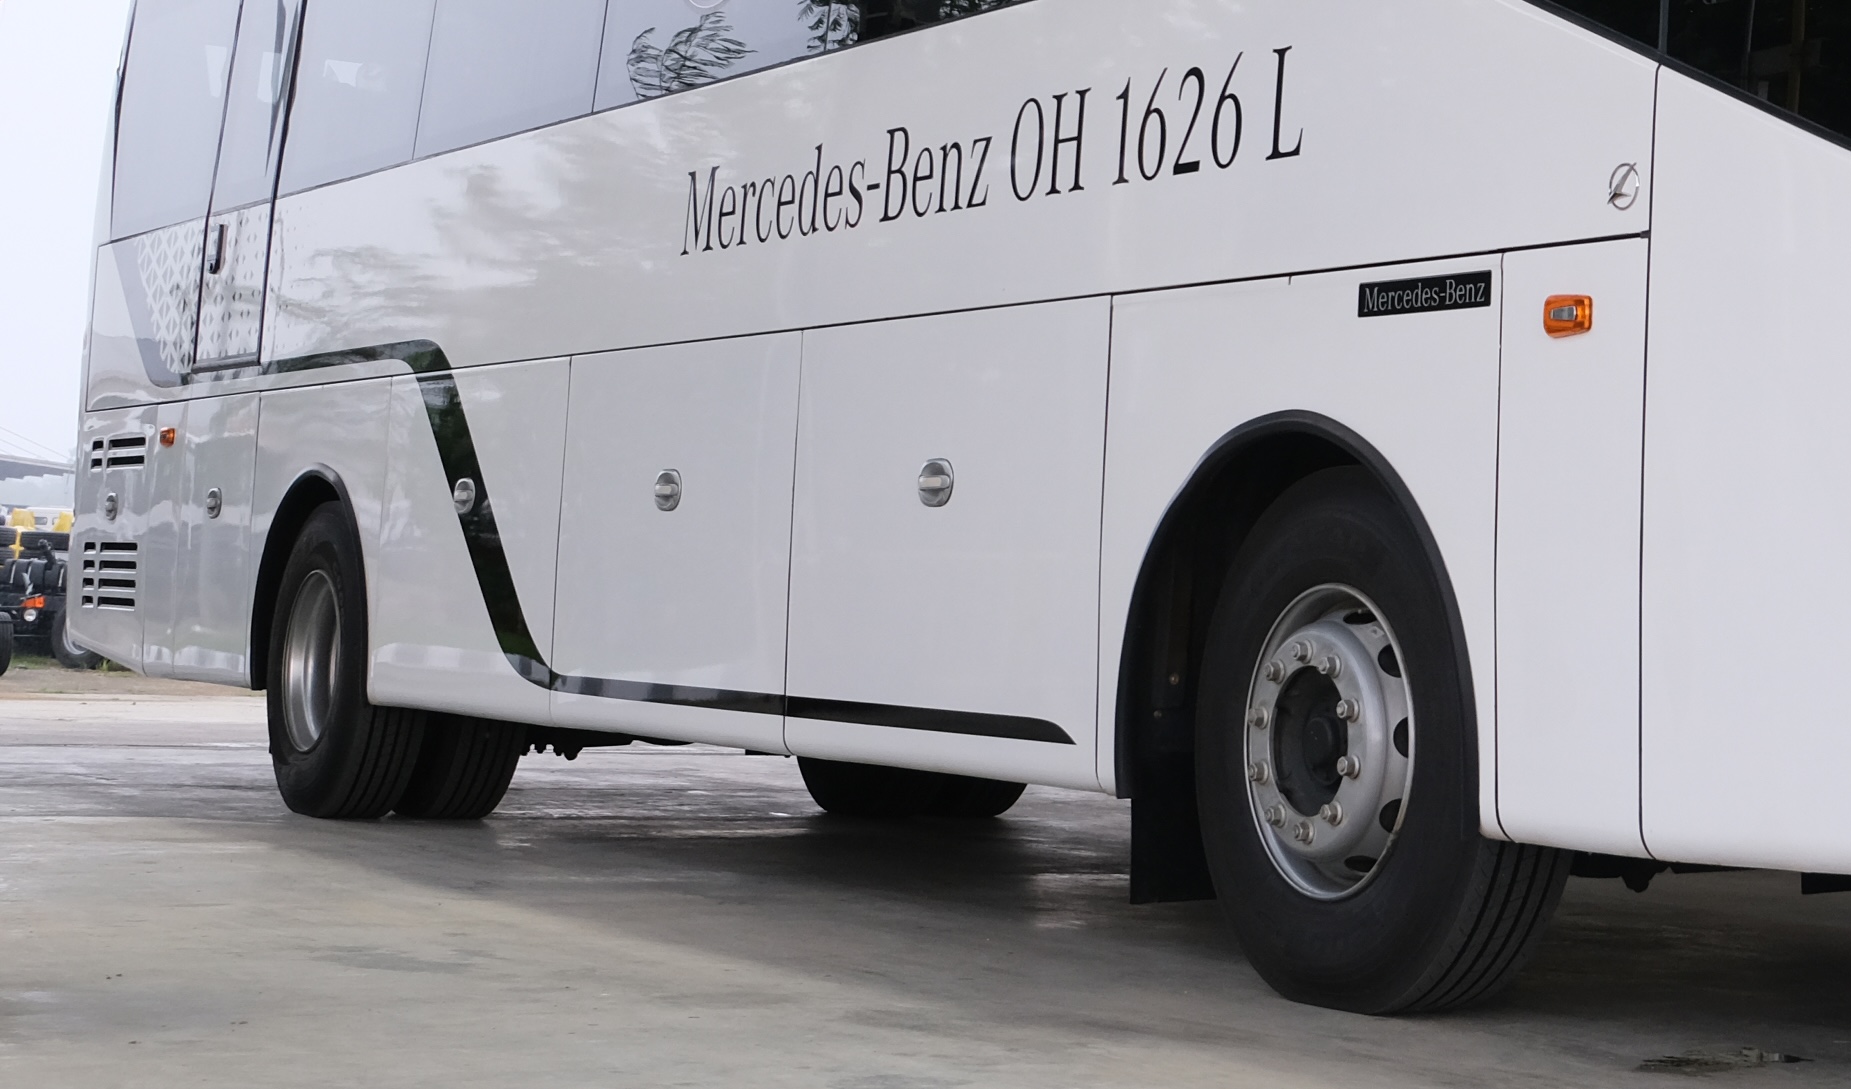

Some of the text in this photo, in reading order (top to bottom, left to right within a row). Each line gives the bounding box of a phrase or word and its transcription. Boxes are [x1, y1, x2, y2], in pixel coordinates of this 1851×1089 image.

[680, 44, 1304, 256] Mercedes-Benz OH 1626 L
[1363, 278, 1487, 313] Mercedes-Benz
